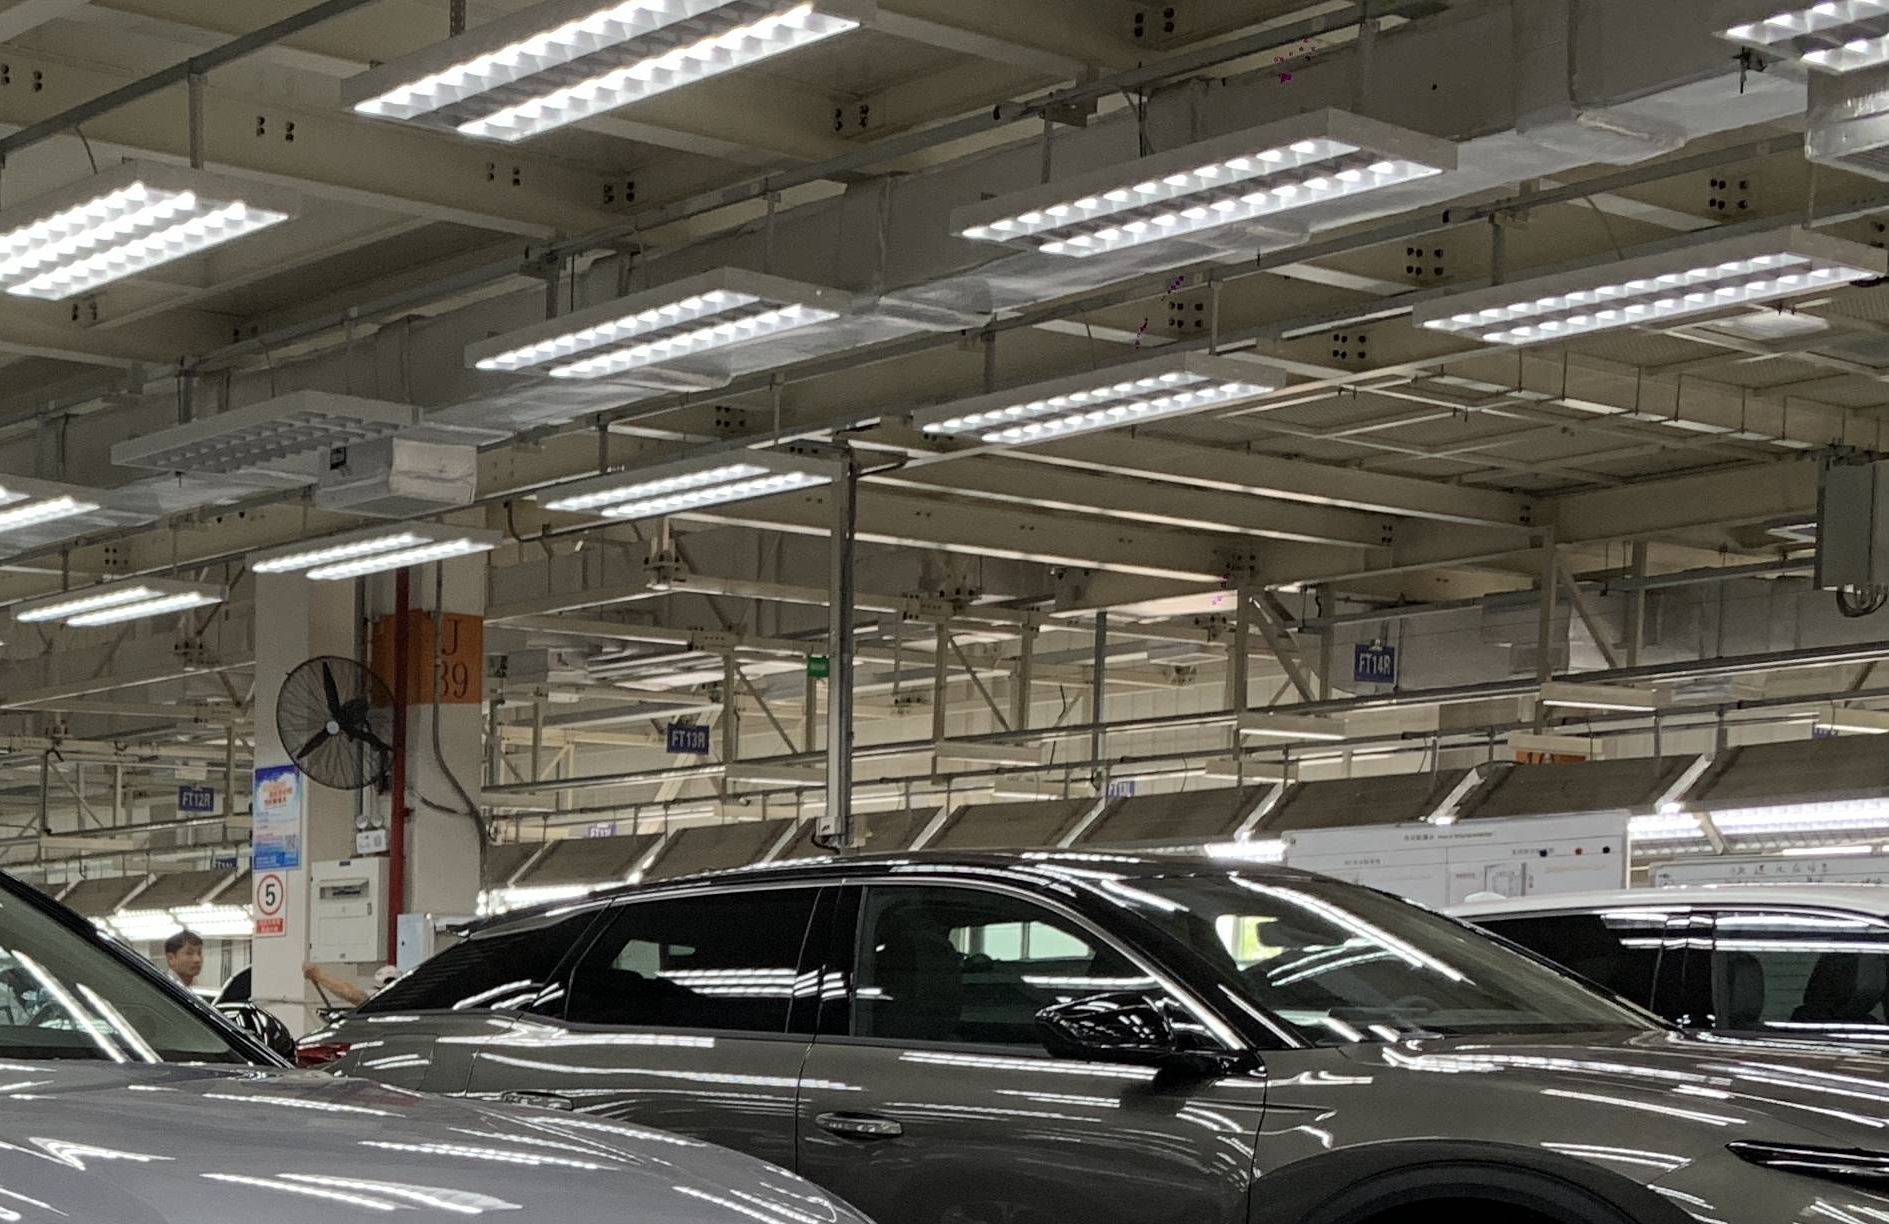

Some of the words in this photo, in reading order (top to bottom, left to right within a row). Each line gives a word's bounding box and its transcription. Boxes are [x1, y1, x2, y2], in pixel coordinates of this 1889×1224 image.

[441, 619, 462, 656] J
[1359, 653, 1390, 675] FT14R
[671, 730, 706, 749] FT13R
[182, 791, 211, 807] FT12R
[265, 883, 276, 907] 5
